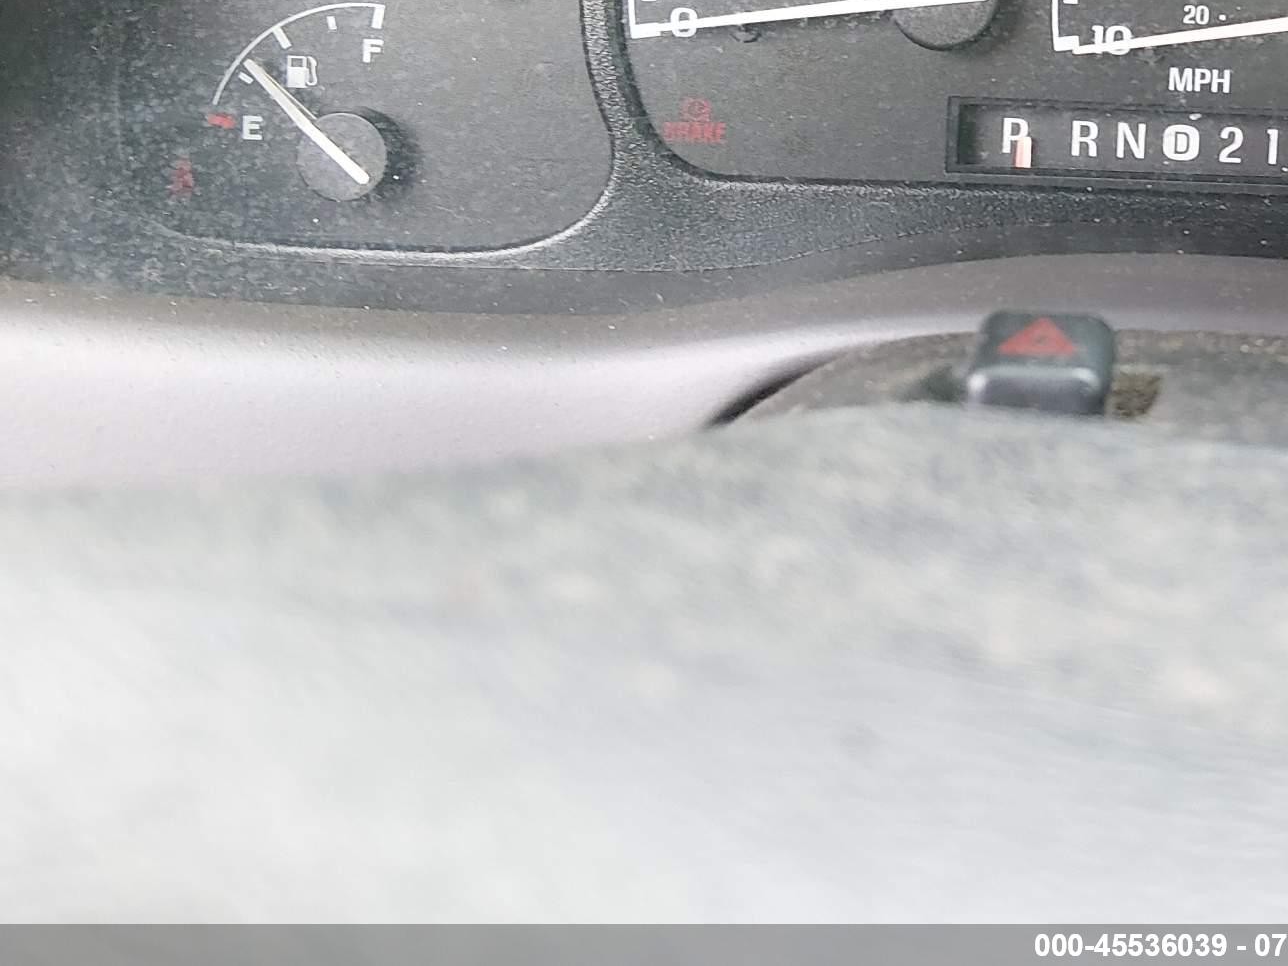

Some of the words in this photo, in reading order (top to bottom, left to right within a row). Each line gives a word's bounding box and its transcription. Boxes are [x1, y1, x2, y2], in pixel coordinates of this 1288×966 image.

[670, 7, 698, 37] 0
[1182, 4, 1210, 25] 20
[362, 38, 384, 63] F
[1092, 25, 1132, 56] 10
[1168, 67, 1231, 94] MPH
[241, 115, 262, 141] E
[1002, 117, 1029, 154] P
[1071, 120, 1099, 158] R
[1116, 122, 1147, 160] N
